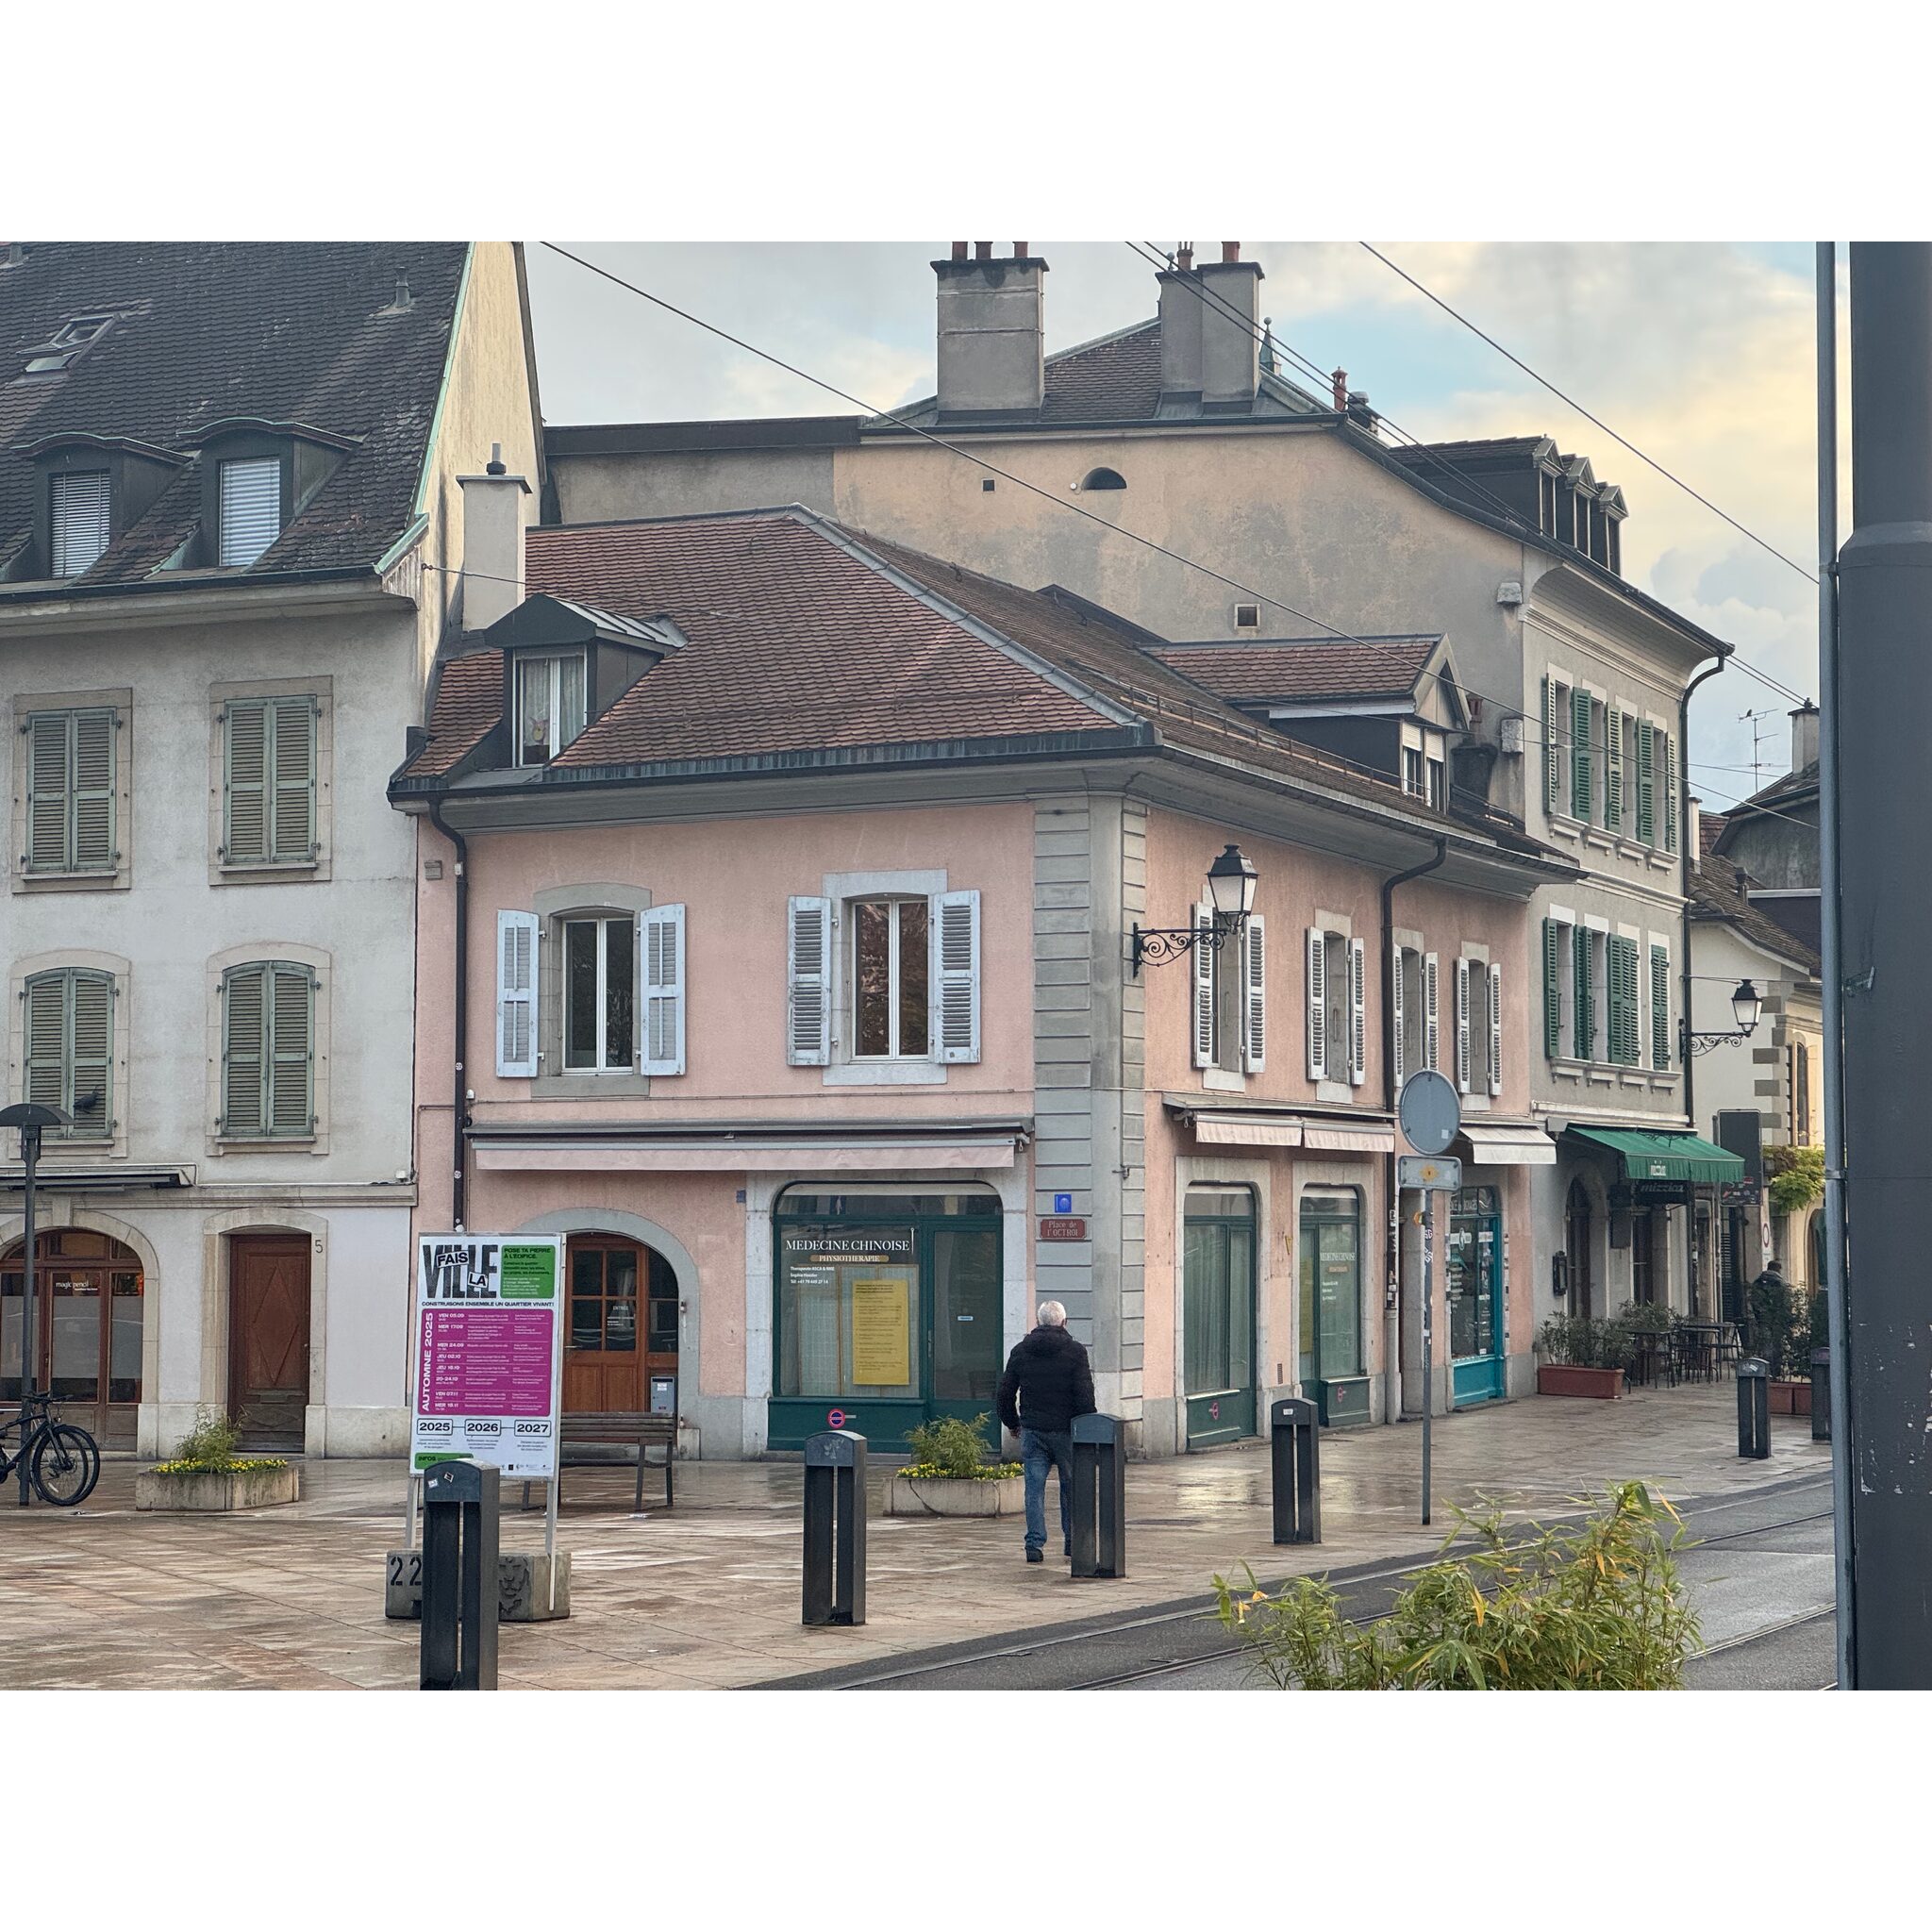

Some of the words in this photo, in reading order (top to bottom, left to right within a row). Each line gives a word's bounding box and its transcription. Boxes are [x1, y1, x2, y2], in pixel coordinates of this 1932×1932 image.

[314, 1239, 324, 1254] 5
[786, 1240, 849, 1251] MEDECINE
[851, 1240, 910, 1251] CHINOISE
[437, 1252, 469, 1266] FAIS
[423, 1244, 498, 1298] VILLE
[425, 1312, 433, 1347] 2025
[422, 1350, 431, 1411] AUTOMNE
[419, 1422, 450, 1431] 2025
[467, 1423, 498, 1432] 2026
[517, 1424, 549, 1433] 2027
